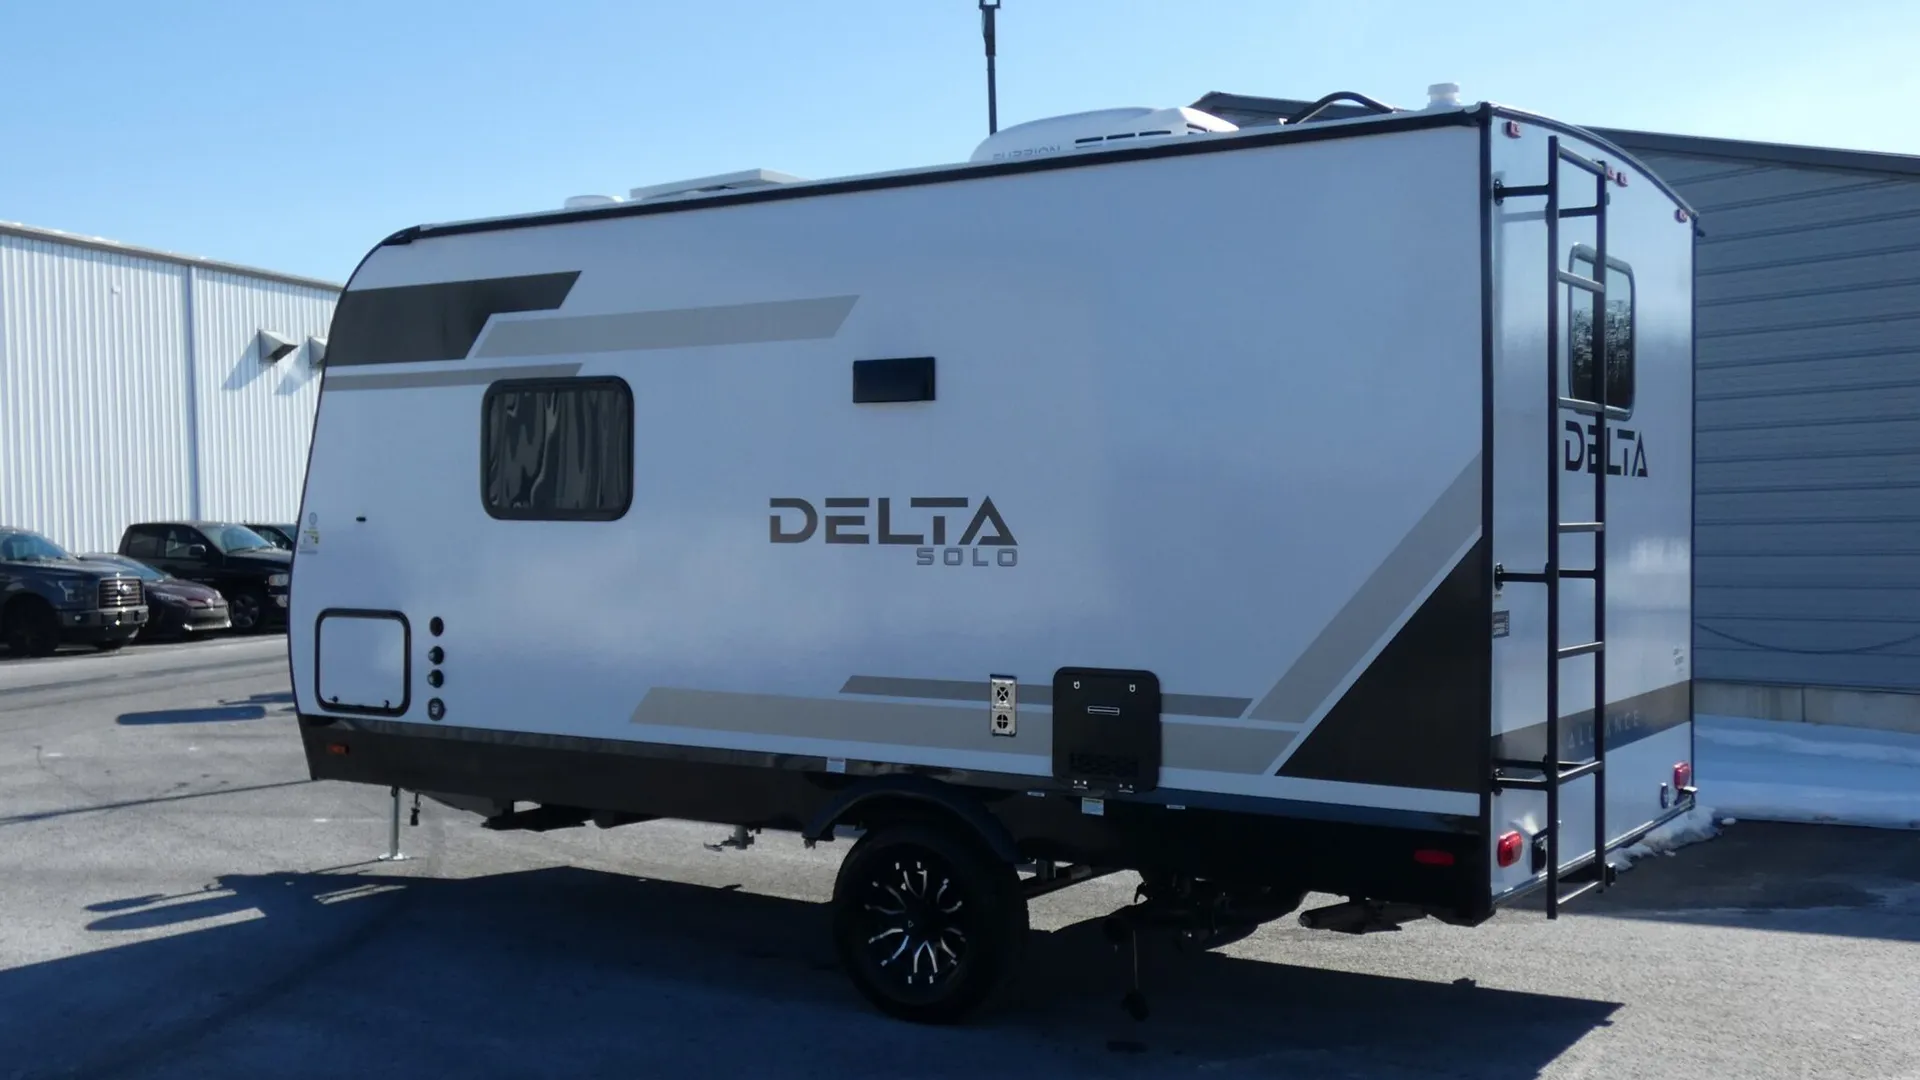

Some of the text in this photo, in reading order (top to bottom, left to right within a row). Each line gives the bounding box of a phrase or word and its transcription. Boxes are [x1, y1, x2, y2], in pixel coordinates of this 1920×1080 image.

[769, 496, 1018, 546] DELTA
[916, 547, 1018, 567] SOLO
[1568, 709, 1640, 749] ALLANCE
